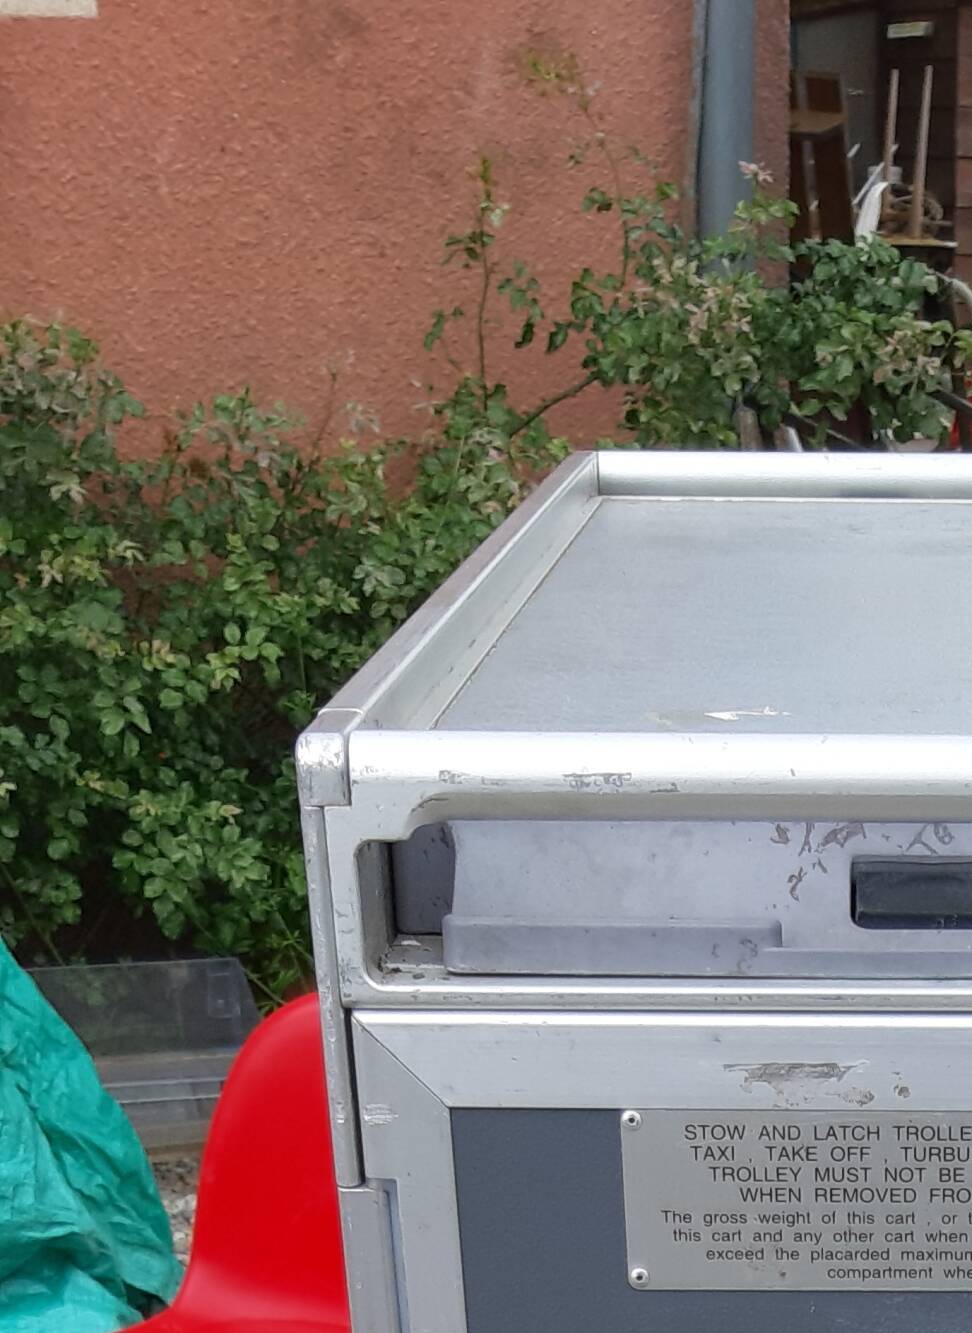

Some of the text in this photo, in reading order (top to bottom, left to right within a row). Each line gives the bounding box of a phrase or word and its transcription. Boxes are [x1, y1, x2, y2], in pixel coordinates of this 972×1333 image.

[683, 1123, 746, 1141] STOW
[757, 1124, 802, 1142] AND
[813, 1124, 881, 1142] LATCH
[689, 1145, 735, 1162] TAXI
[764, 1145, 819, 1163] TAKE
[830, 1145, 872, 1163] OFF
[707, 1165, 802, 1183] TROLLEY
[814, 1166, 873, 1183] MUST
[884, 1166, 928, 1184] NOT
[938, 1166, 966, 1184] BE
[739, 1186, 802, 1204] WHEN
[814, 1187, 917, 1204] REMOVED
[660, 1209, 693, 1224] The
[702, 1213, 748, 1228] gross
[757, 1210, 811, 1228] weight
[821, 1210, 837, 1225] of
[847, 1210, 875, 1225] this
[885, 1211, 916, 1225] cart
[941, 1214, 958, 1225] or
[672, 1227, 702, 1243] this
[711, 1228, 742, 1243] cart
[752, 1228, 783, 1243] and
[793, 1231, 823, 1246] any
[832, 1226, 875, 1243] other
[884, 1229, 915, 1243] cart
[924, 1229, 969, 1243] when
[705, 1247, 765, 1261] exceed
[773, 1245, 800, 1261] the
[810, 1246, 890, 1265] placarded
[827, 1265, 933, 1283] compartment
